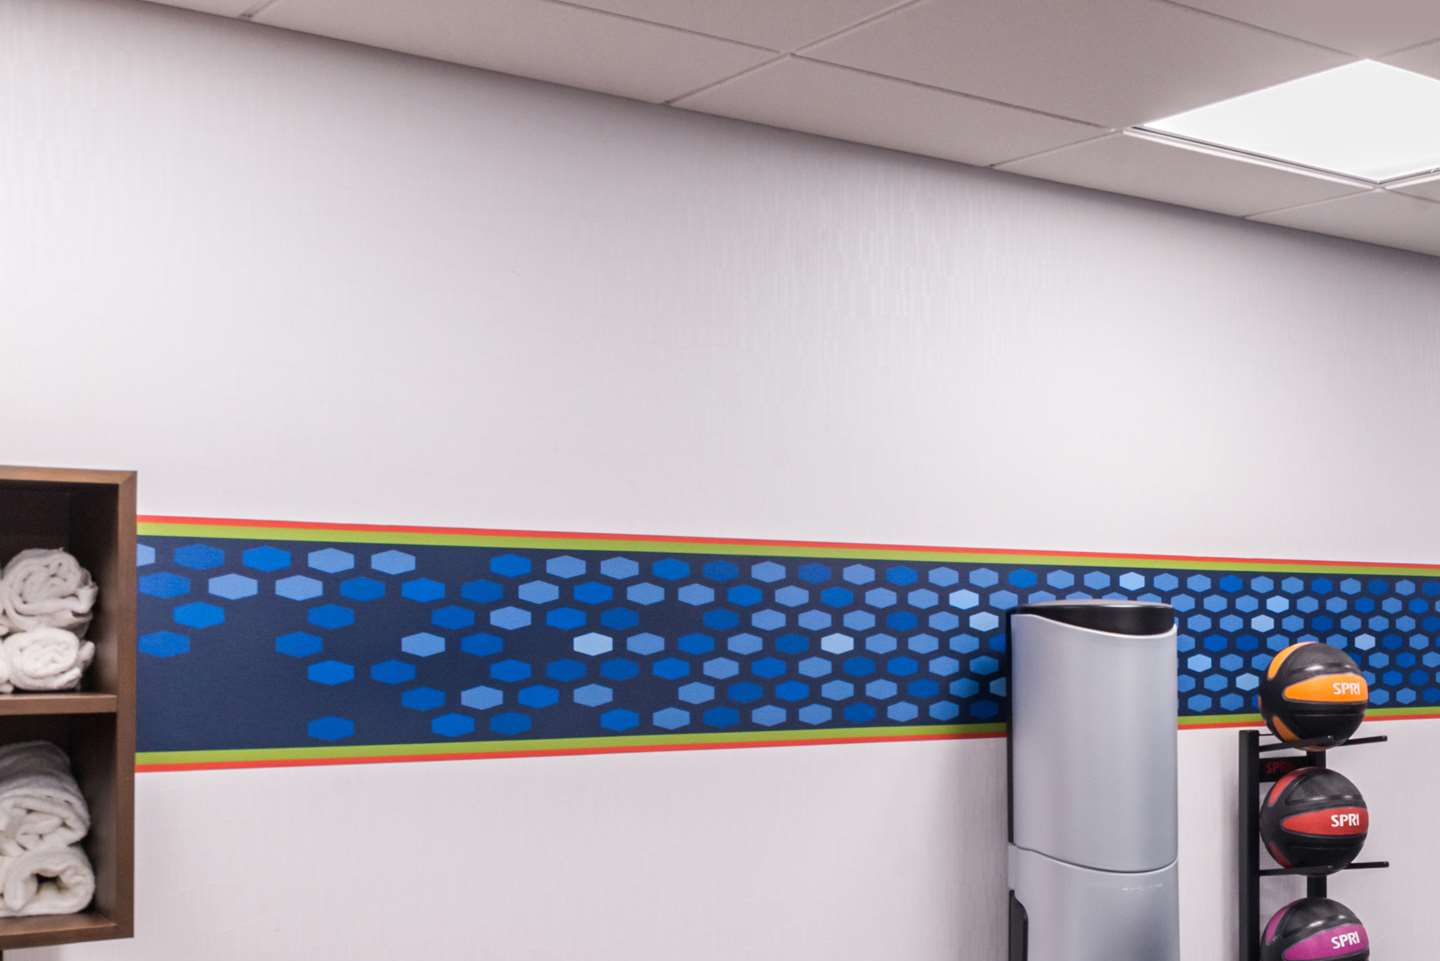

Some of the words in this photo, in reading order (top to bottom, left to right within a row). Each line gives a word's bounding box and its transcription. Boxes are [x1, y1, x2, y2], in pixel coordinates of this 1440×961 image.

[1332, 682, 1361, 696] SPRI
[1331, 813, 1360, 828] SPRI
[1331, 931, 1361, 950] SPRI
